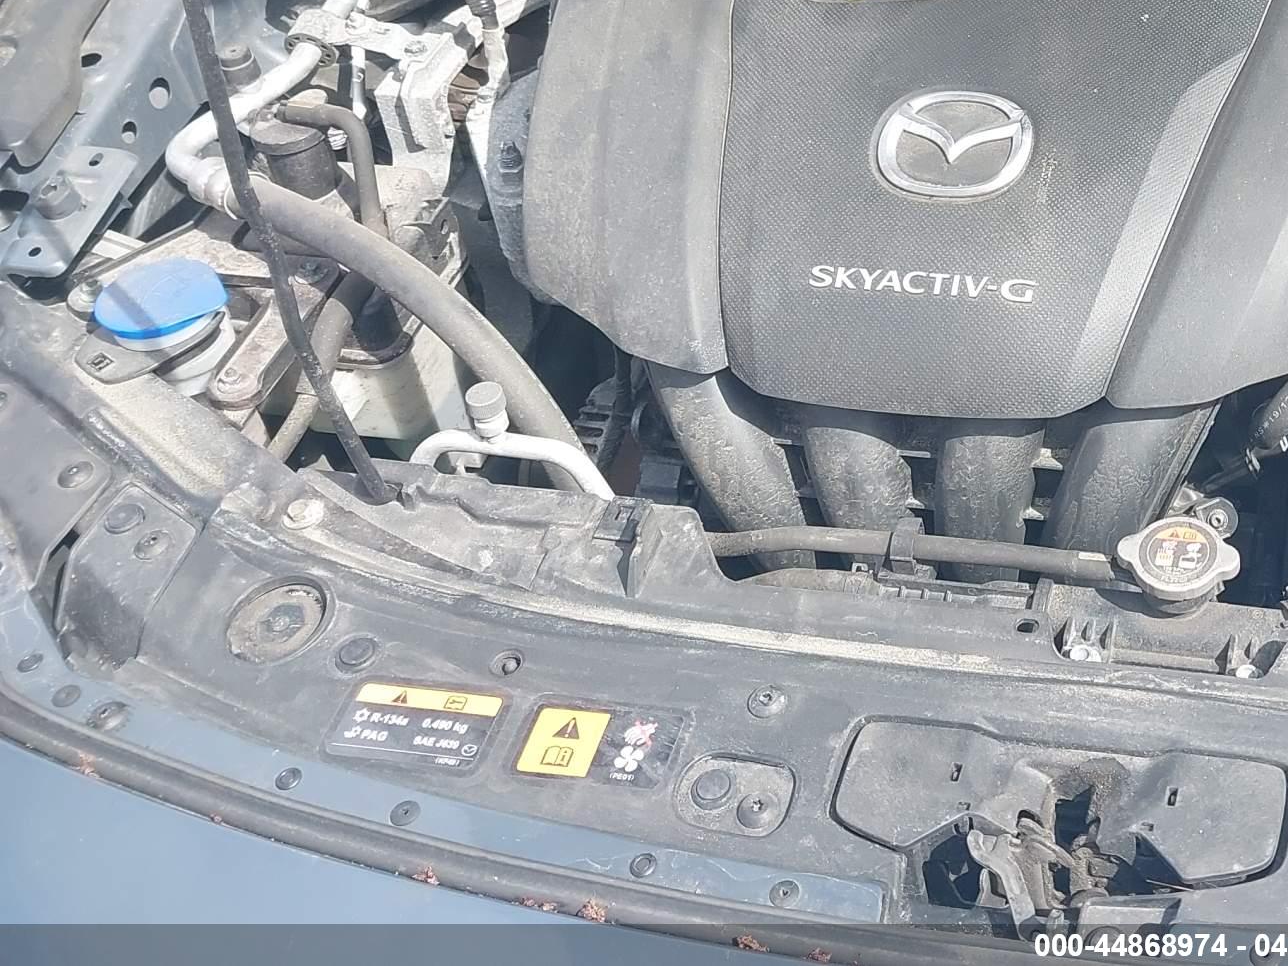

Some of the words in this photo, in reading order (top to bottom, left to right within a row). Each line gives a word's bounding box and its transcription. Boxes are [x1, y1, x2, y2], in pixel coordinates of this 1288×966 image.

[808, 264, 1040, 303] SKYACTIV-G
[360, 728, 390, 742] PAG
[369, 712, 410, 727] R-134a
[452, 721, 470, 735] kg
